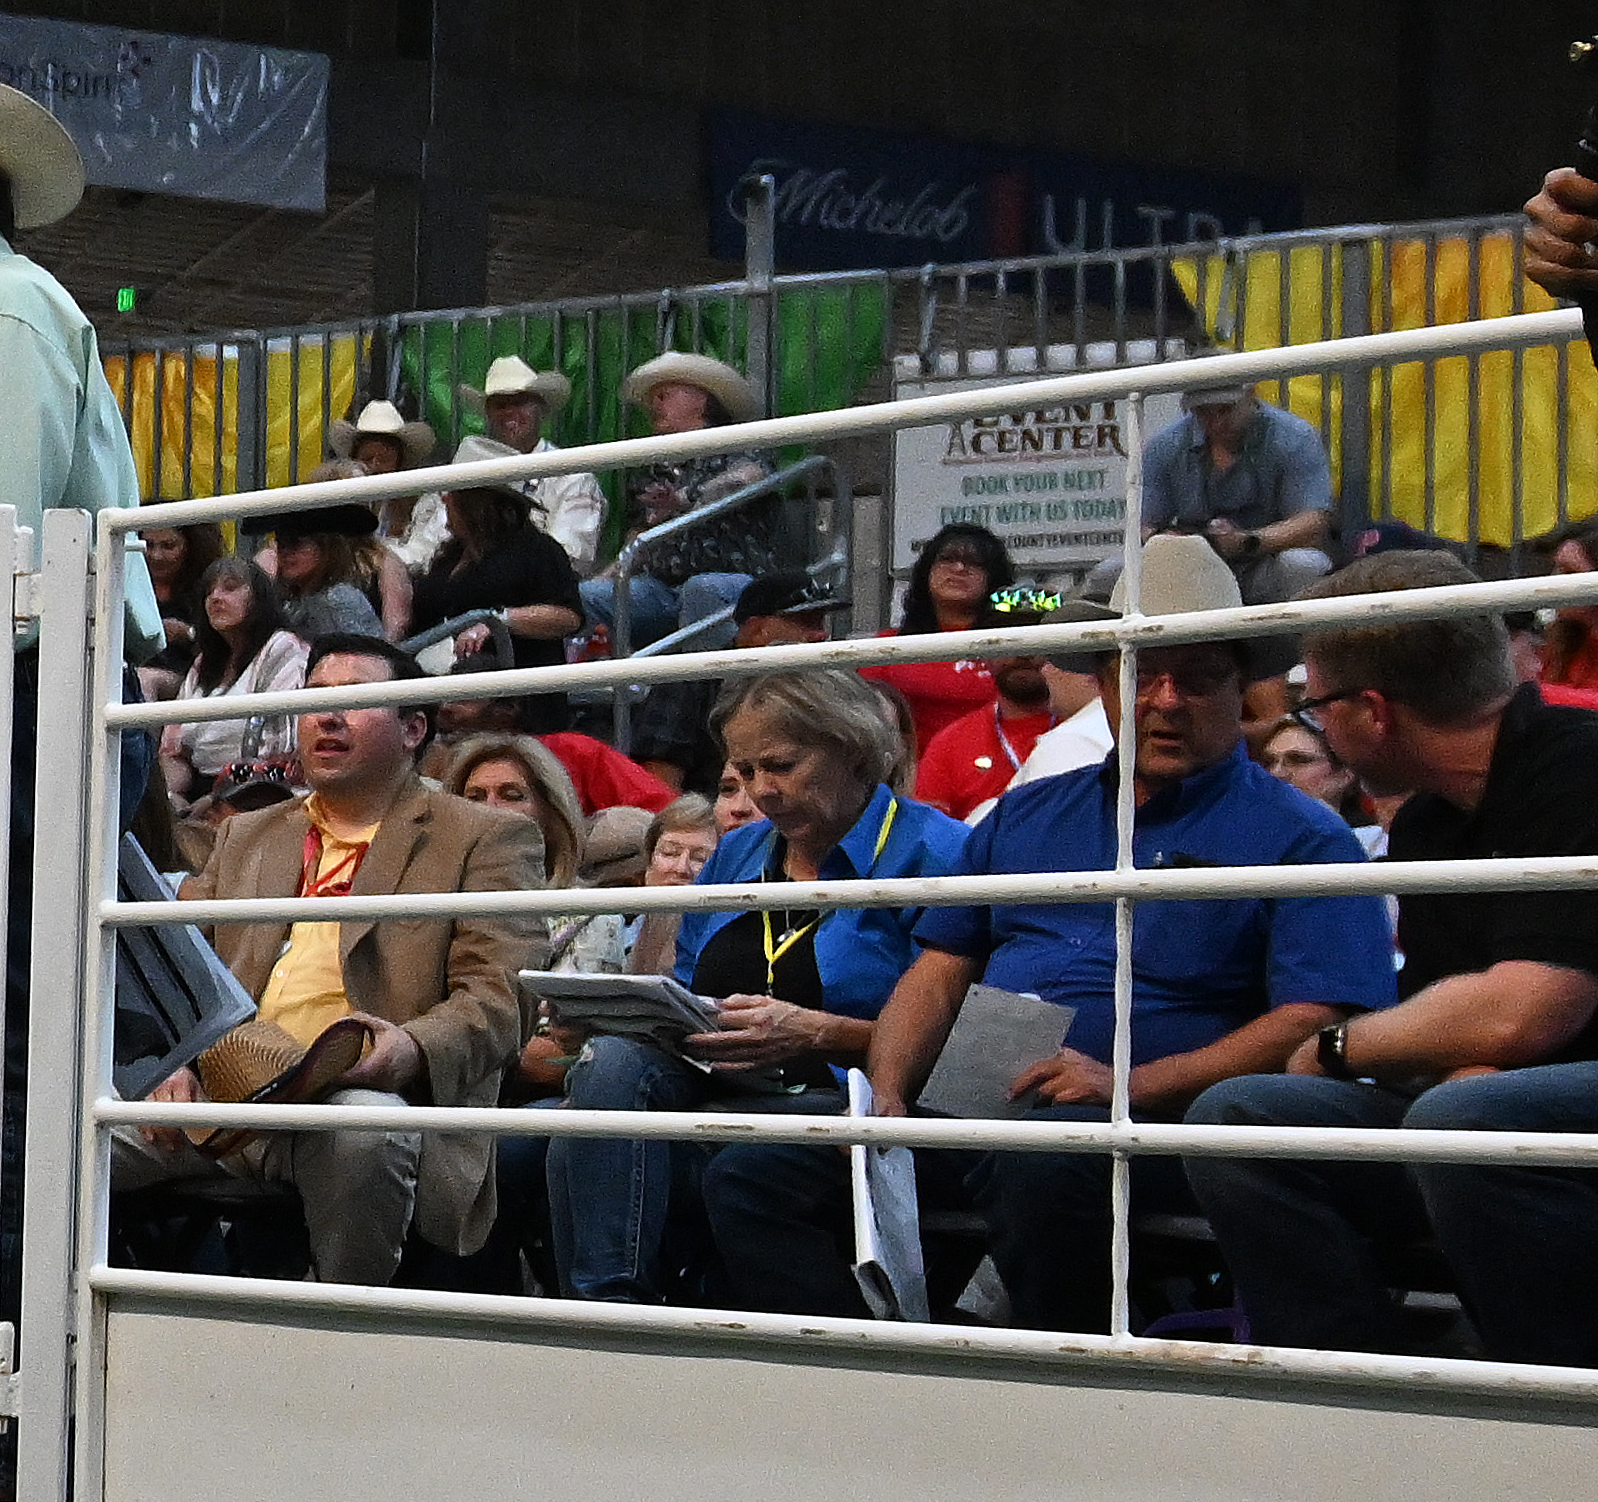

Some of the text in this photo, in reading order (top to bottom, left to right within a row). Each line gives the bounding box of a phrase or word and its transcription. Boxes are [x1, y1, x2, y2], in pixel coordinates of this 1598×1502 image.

[971, 424, 1128, 459] CENTER
[962, 469, 1105, 497] BOOK YOUR NEXT
[941, 498, 1126, 526] EVENT WITH US TODAY
